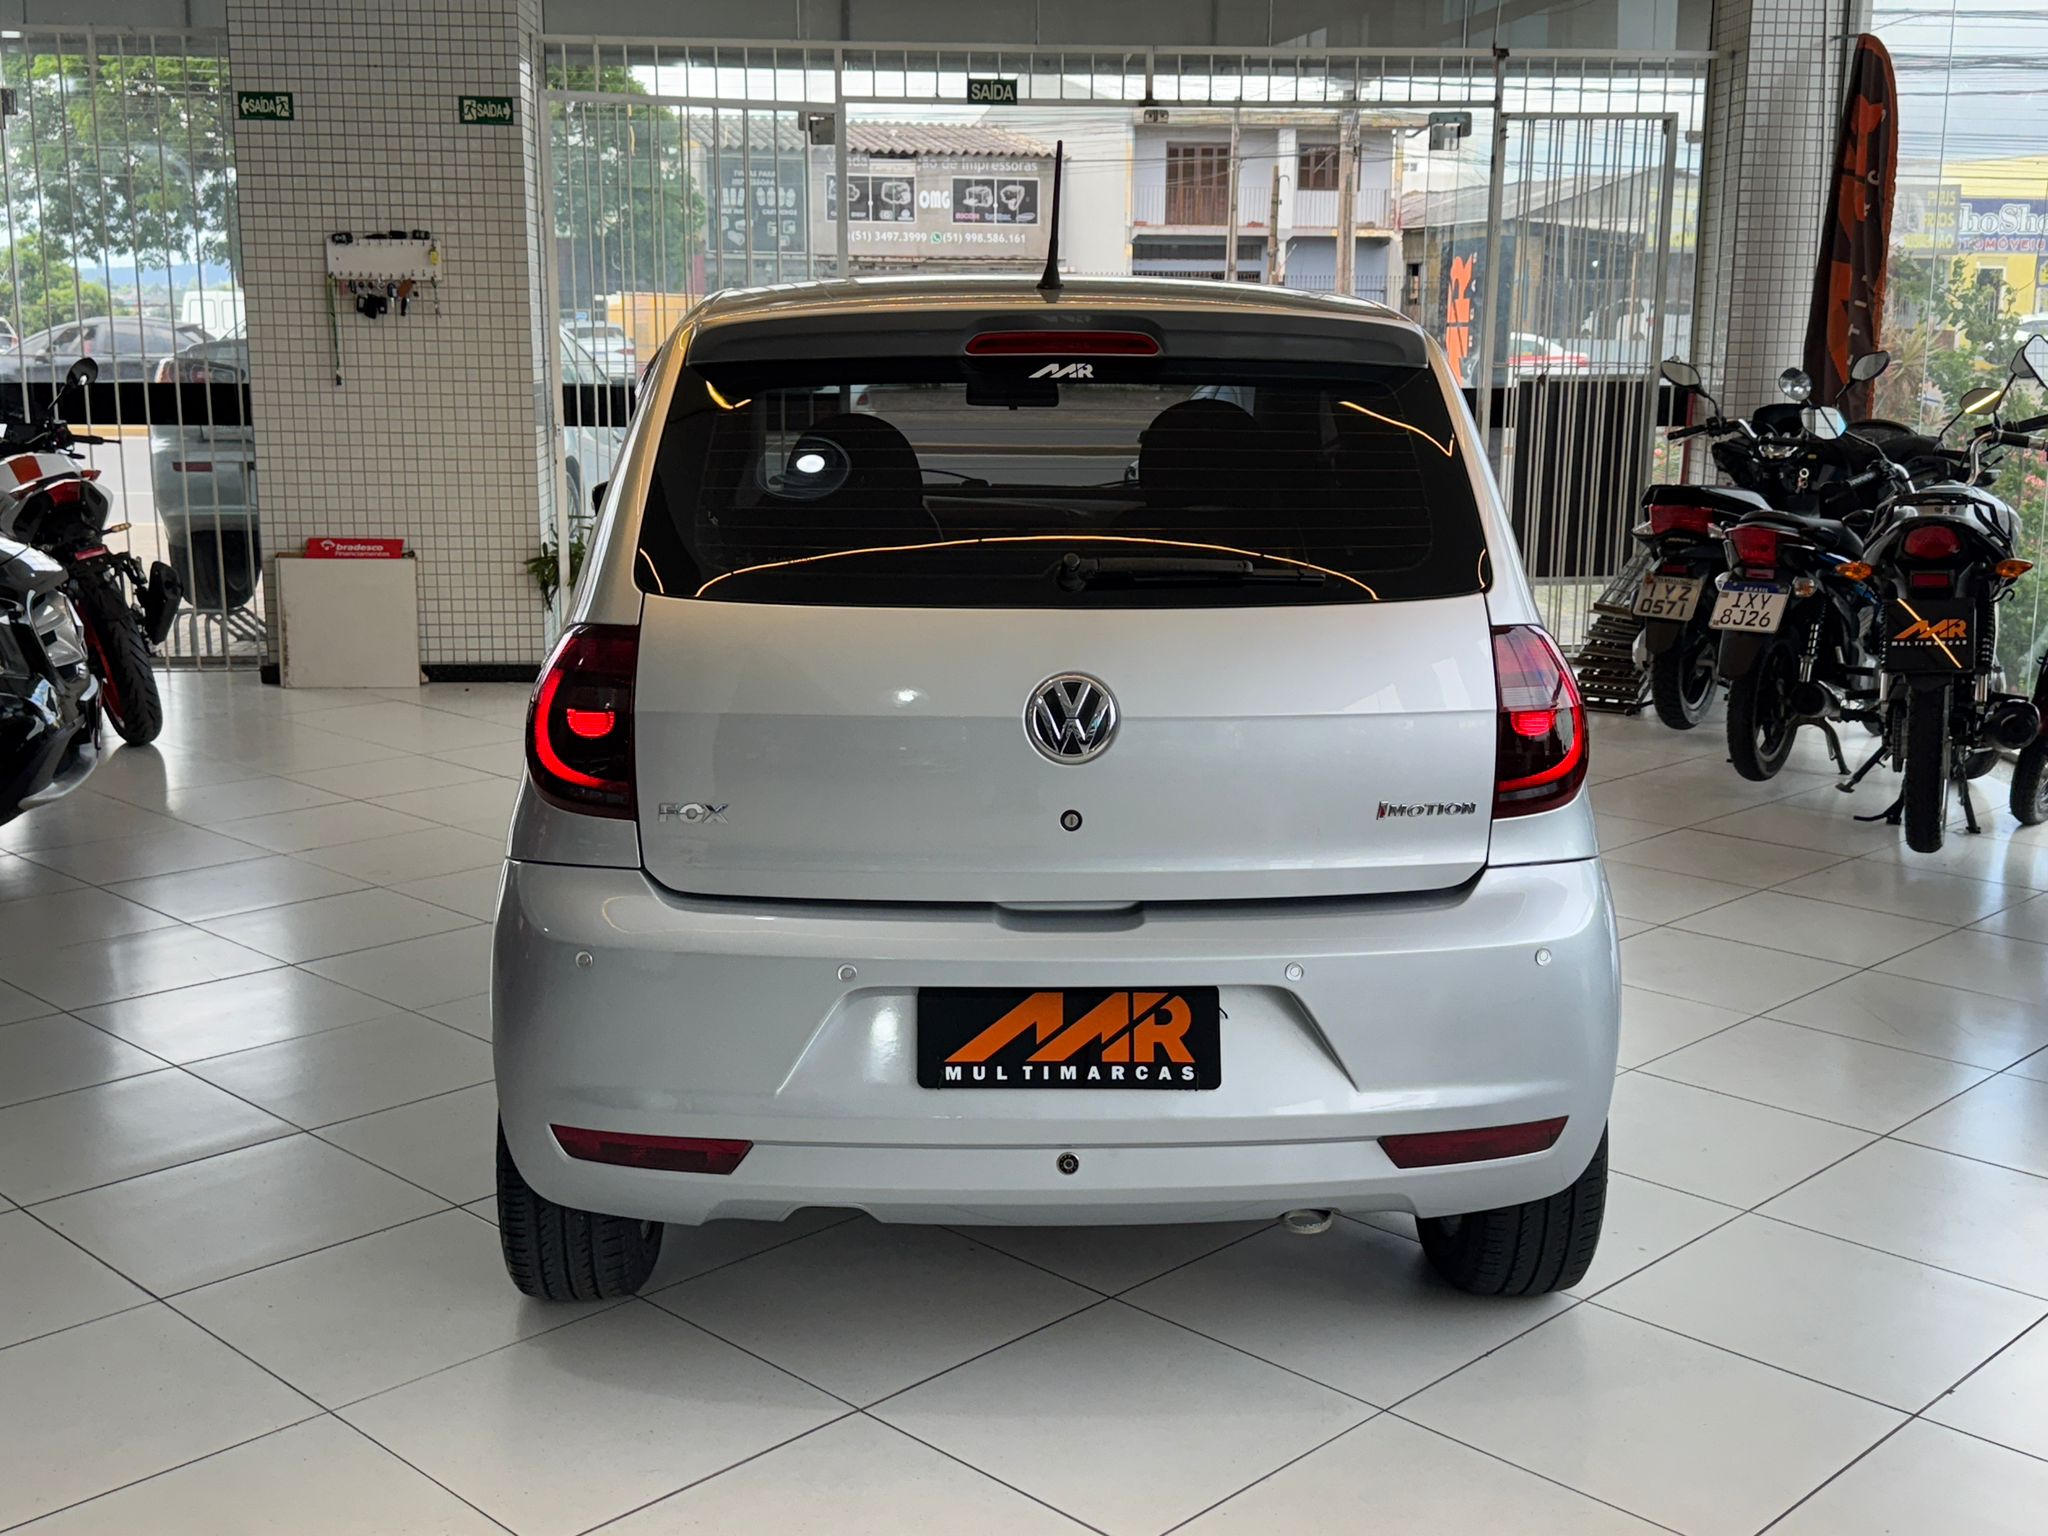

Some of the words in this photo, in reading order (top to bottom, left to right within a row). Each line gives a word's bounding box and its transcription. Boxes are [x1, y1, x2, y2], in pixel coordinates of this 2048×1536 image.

[971, 81, 1014, 100] SAÍDA
[248, 95, 275, 113] SAÍDA
[477, 100, 503, 118] SAÍDA
[961, 158, 1038, 173] Impressoras
[919, 190, 951, 209] OMG
[851, 230, 872, 242] (51)
[875, 231, 927, 242] 3497.3999
[942, 233, 962, 244] (51)
[965, 233, 1026, 244] 998.586.161
[336, 543, 384, 551] bradesco
[1640, 598, 1686, 617] 0571
[1732, 593, 1772, 610] IXY
[1720, 609, 1771, 628] 8J26
[658, 802, 729, 824] FOX
[944, 1065, 1196, 1081] MULTIMARCAS
